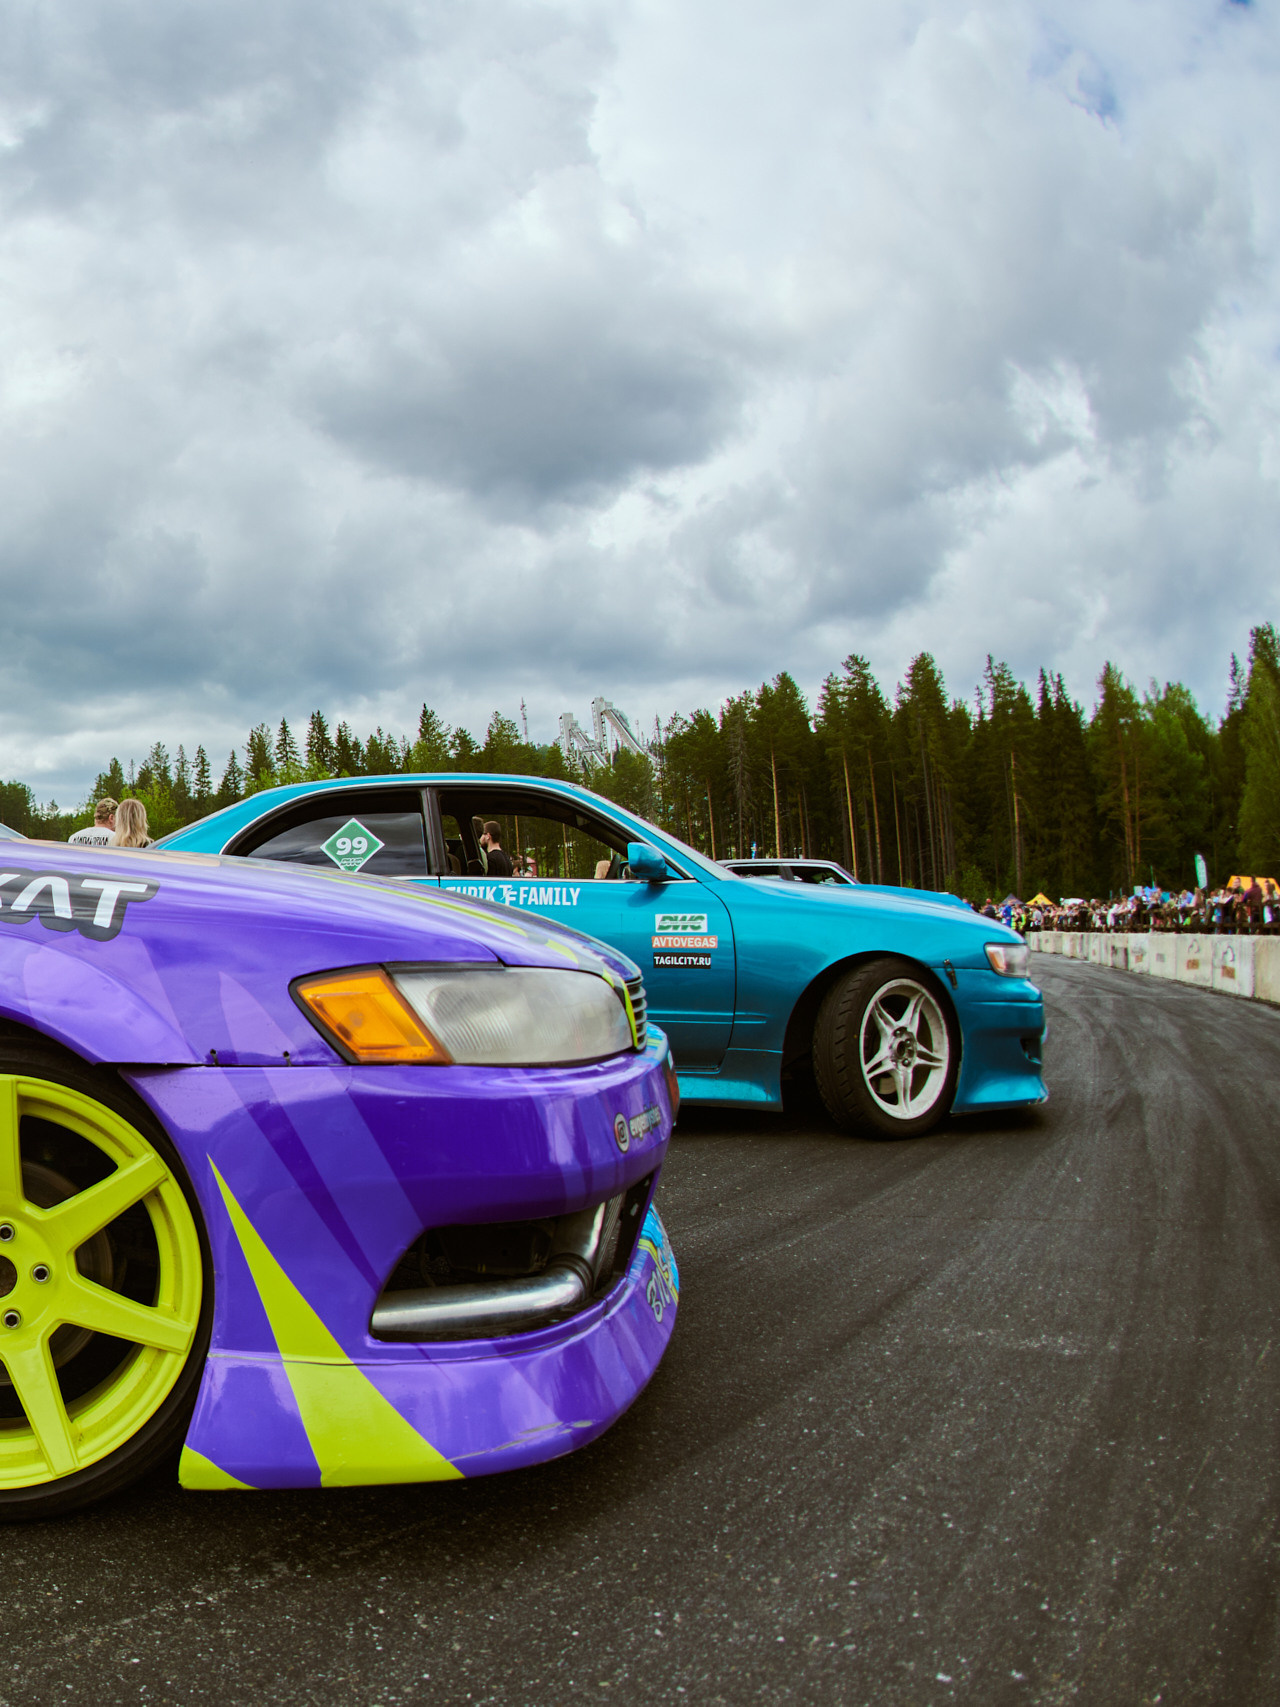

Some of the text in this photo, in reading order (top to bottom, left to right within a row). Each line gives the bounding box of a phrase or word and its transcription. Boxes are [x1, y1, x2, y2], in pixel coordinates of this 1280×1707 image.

[336, 836, 368, 856] 99
[519, 886, 581, 906] FAMILY
[657, 915, 705, 931] DWC
[652, 936, 716, 948] AVTOVEGAS
[654, 956, 711, 966] TAGILCITY.RU
